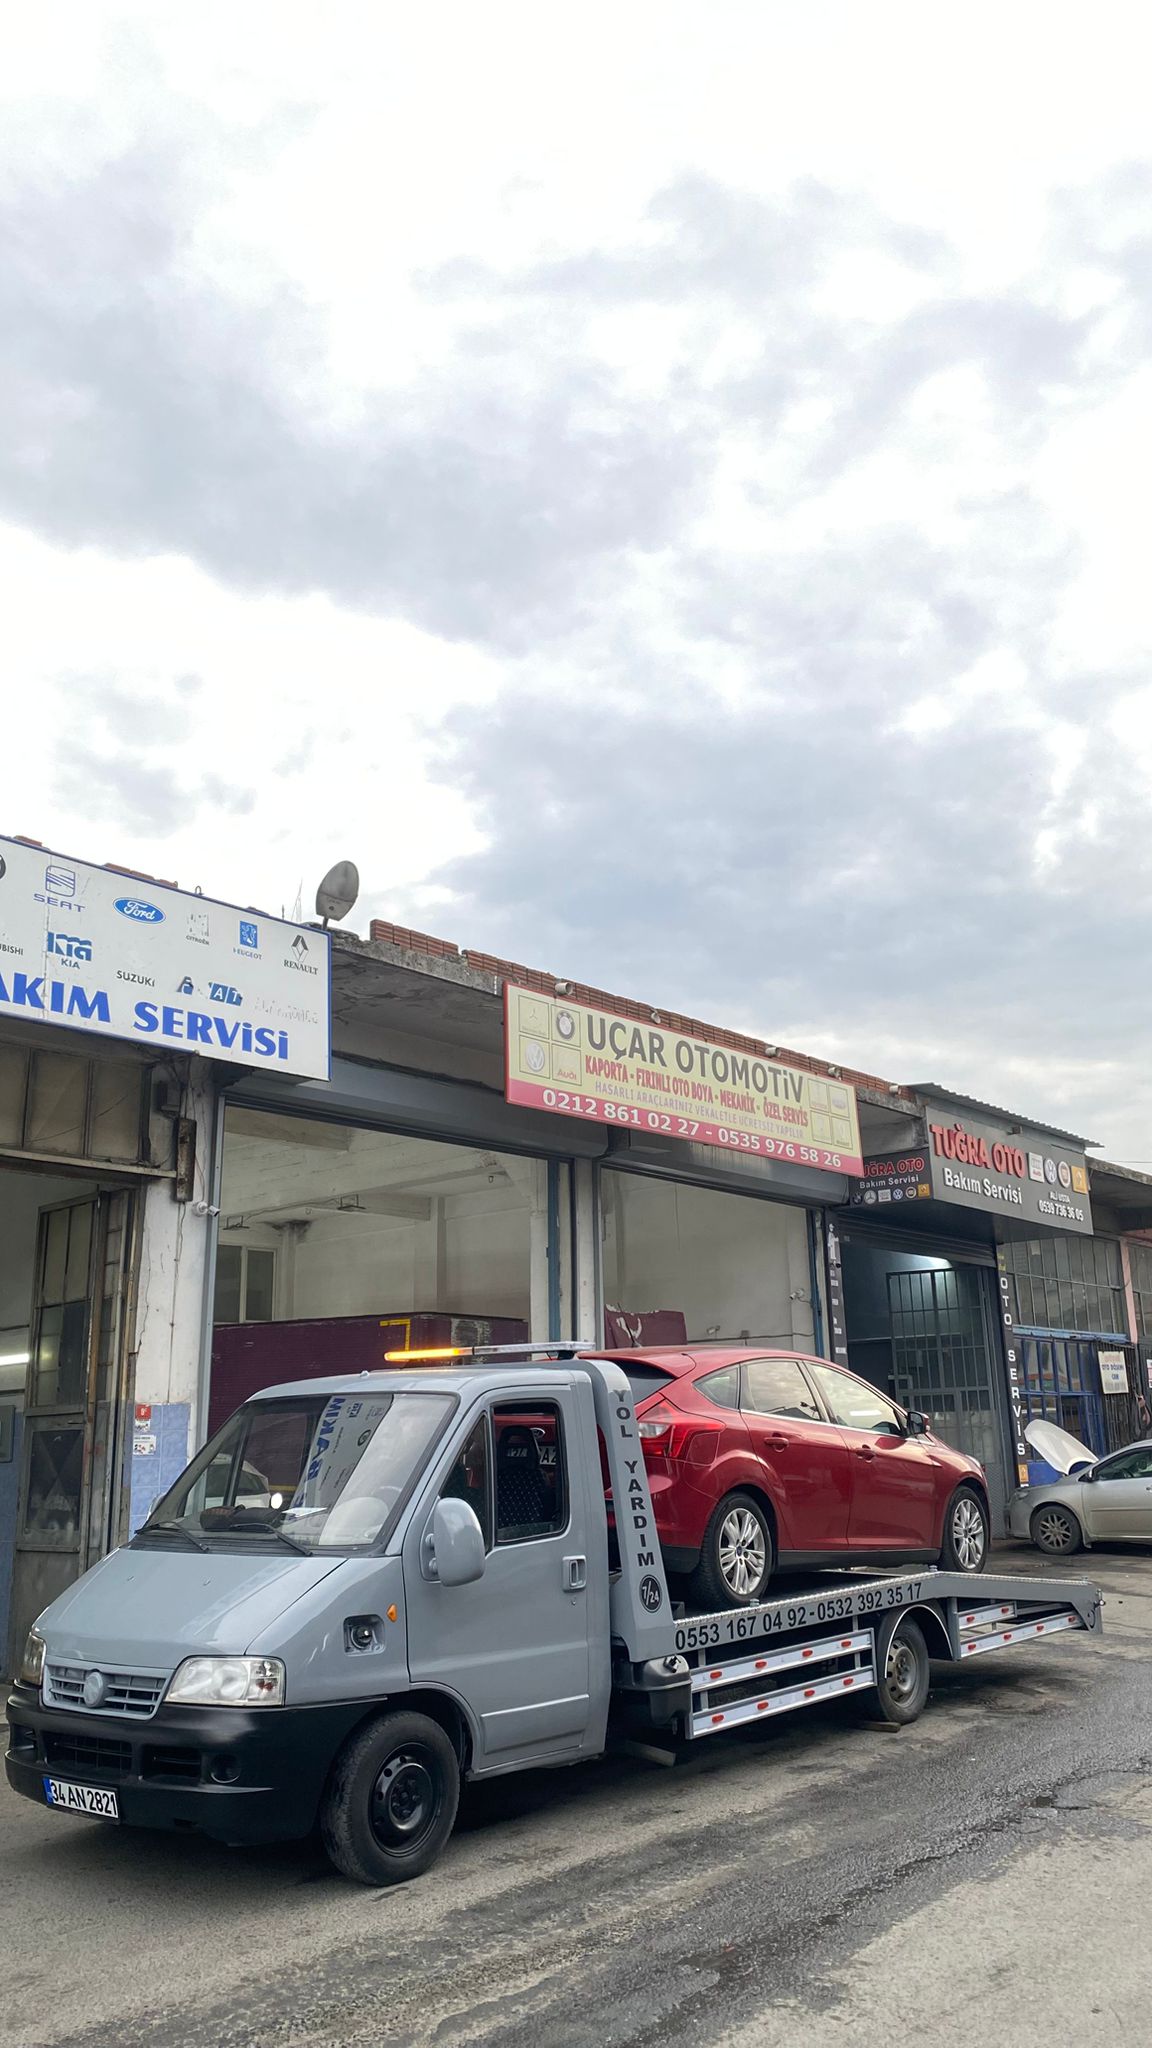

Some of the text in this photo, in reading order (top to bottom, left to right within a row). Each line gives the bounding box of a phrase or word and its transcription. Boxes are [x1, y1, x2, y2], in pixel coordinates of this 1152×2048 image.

[33, 893, 85, 912] SEAT
[123, 899, 156, 921] Ford
[60, 958, 80, 970] KIA
[116, 969, 156, 988] SUZUKI
[283, 958, 318, 976] RENAULT
[586, 1013, 668, 1068] UÇAR
[585, 1055, 808, 1128] KAPORTA FIRINLI OTO BOYA MEKANİK ÖZEL SERVİS
[595, 1080, 634, 1100] HASARLI
[636, 1091, 693, 1114] ARAÇLARINIZ
[542, 1089, 598, 1116] 0212
[603, 1102, 641, 1125] 861
[647, 1112, 672, 1132] 02
[677, 1117, 700, 1137] 27
[718, 1127, 761, 1150] 0535
[765, 1138, 796, 1158] 976
[800, 1146, 819, 1163] 58
[823, 1151, 842, 1168] 26
[896, 1156, 925, 1174] OTO
[929, 1123, 1026, 1179] TUĞRA OTO
[859, 1174, 919, 1189] Bakım Servisi
[943, 1167, 1023, 1205] Bakım Servisi
[1038, 1199, 1055, 1215] 0539
[1000, 1277, 1013, 1326] OTO
[613, 1389, 633, 1438] YOL
[624, 1460, 655, 1567] YARDIM
[641, 1580, 660, 1607] 7/24
[674, 1622, 720, 1651] 0553
[726, 1615, 757, 1640] 167
[762, 1610, 783, 1633] 04
[857, 1589, 883, 1612] 392
[886, 1585, 904, 1606] 35
[906, 1582, 922, 1601] 17
[50, 1781, 118, 1816] 34 AN 2821
